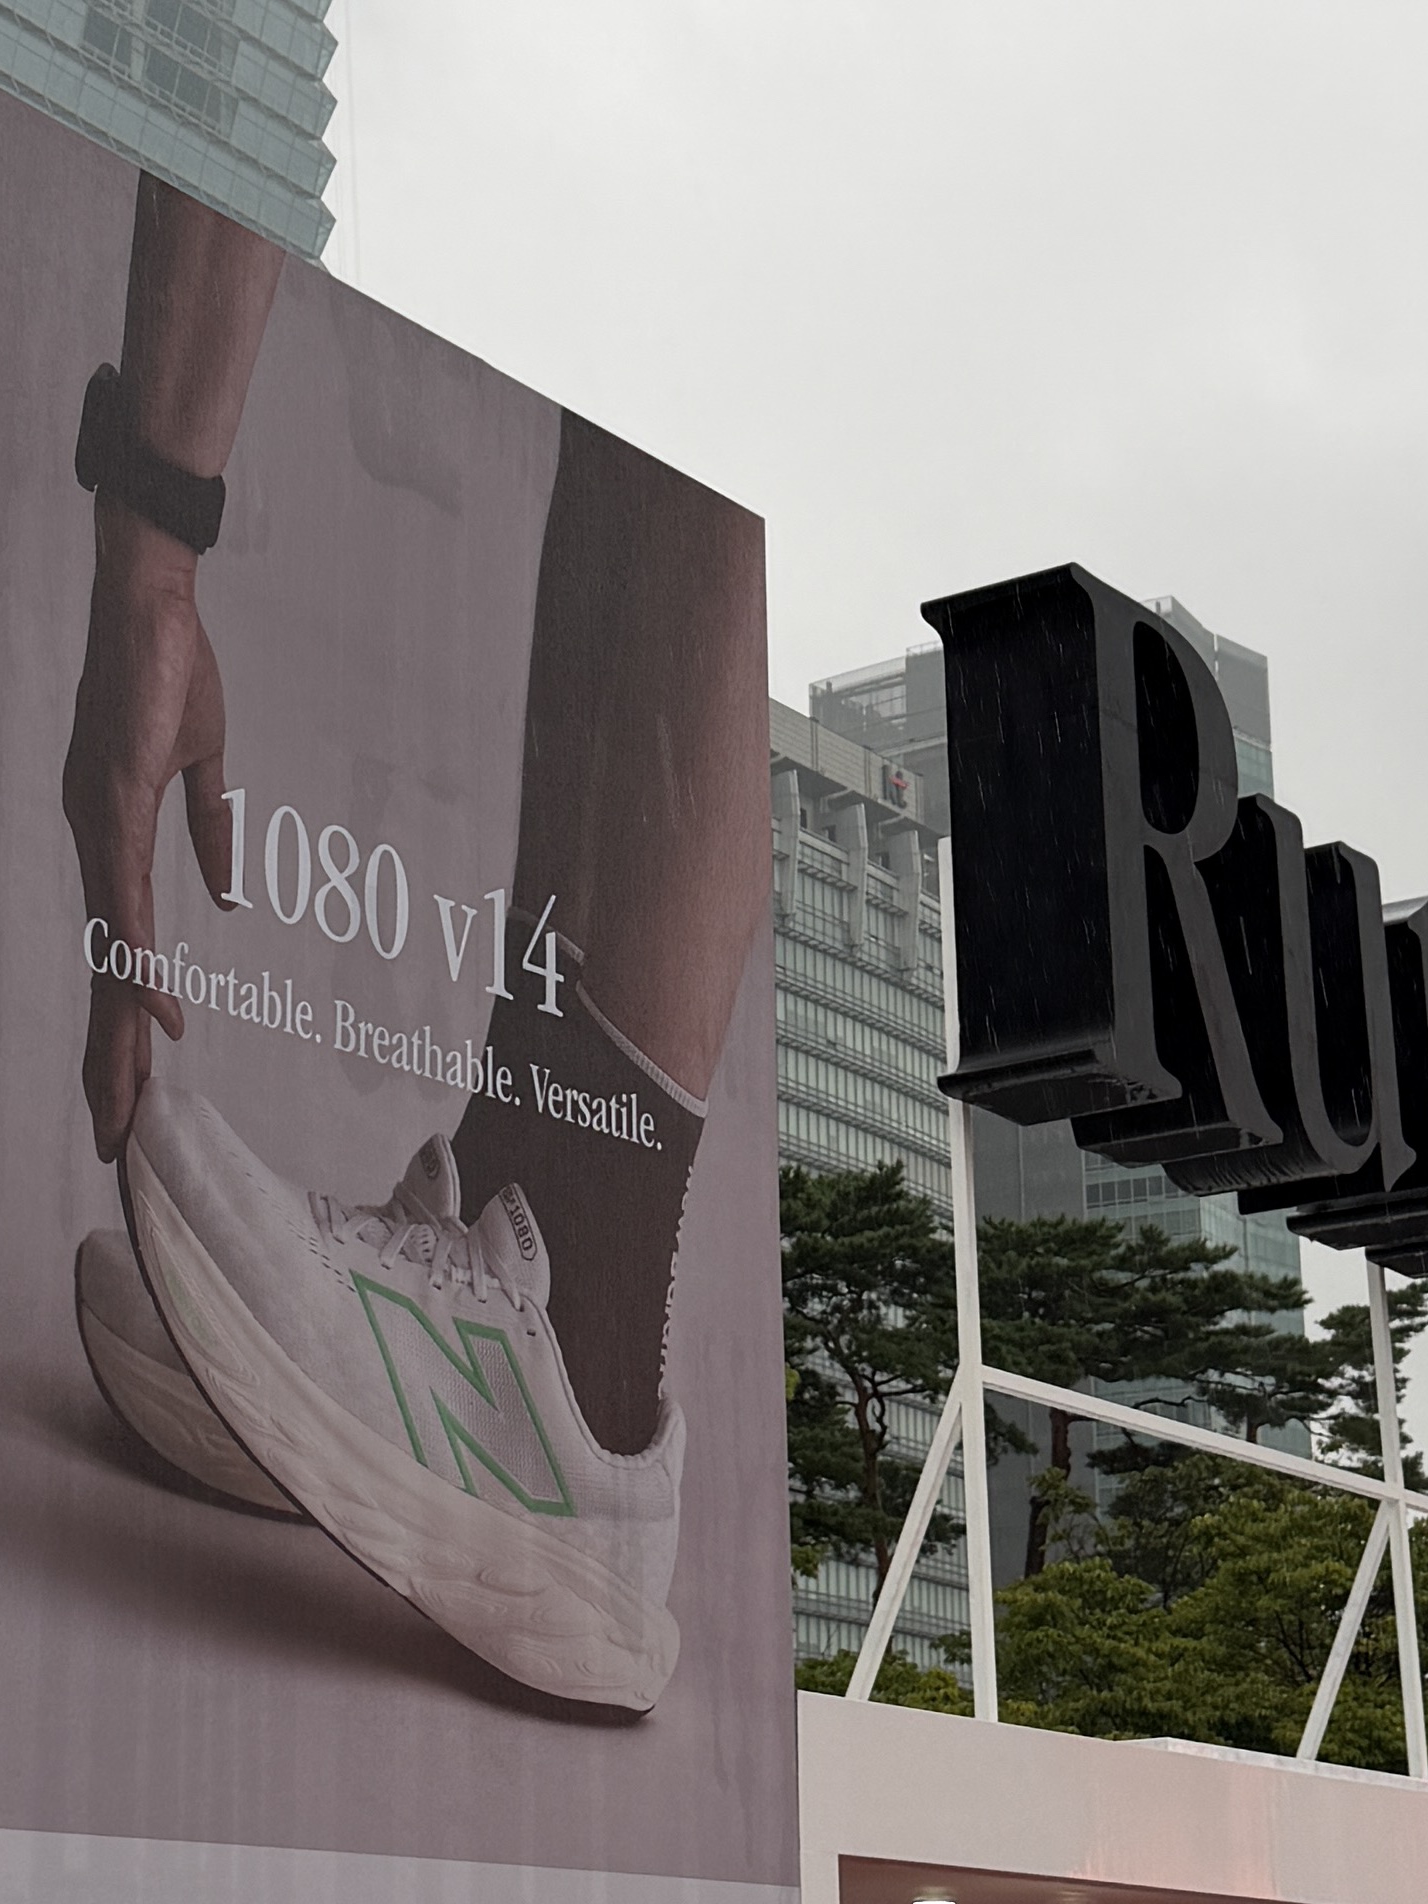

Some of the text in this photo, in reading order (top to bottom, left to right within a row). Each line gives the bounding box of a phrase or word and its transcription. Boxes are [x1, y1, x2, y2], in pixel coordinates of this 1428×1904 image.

[220, 787, 565, 1019] 1080 v14
[82, 916, 664, 1152] Comfortable. Breathable. Versatile.
